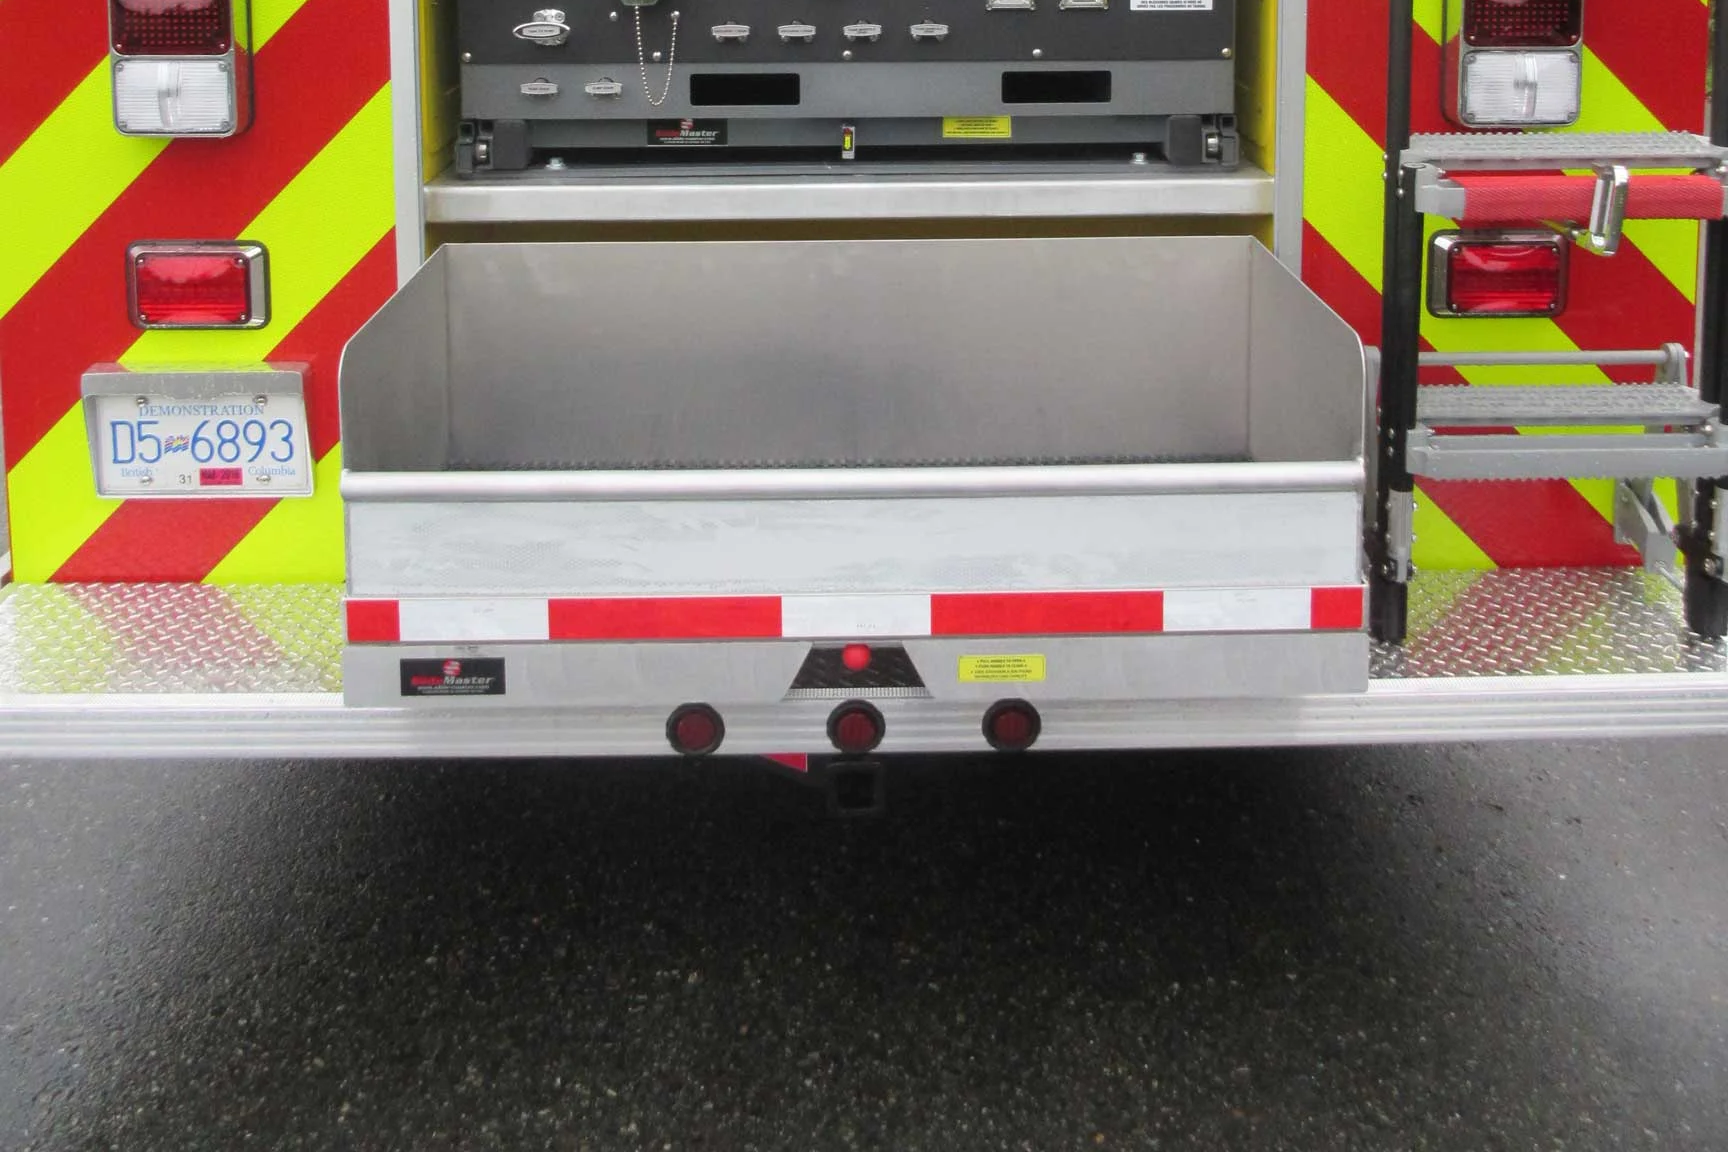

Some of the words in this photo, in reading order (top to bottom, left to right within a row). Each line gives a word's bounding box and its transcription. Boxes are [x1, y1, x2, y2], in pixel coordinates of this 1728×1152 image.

[139, 405, 264, 416] DEMONSTRATION
[110, 420, 163, 464] D5
[191, 419, 294, 464] 6893
[121, 467, 153, 477] British
[248, 466, 296, 477] Columbia
[179, 473, 192, 485] 31
